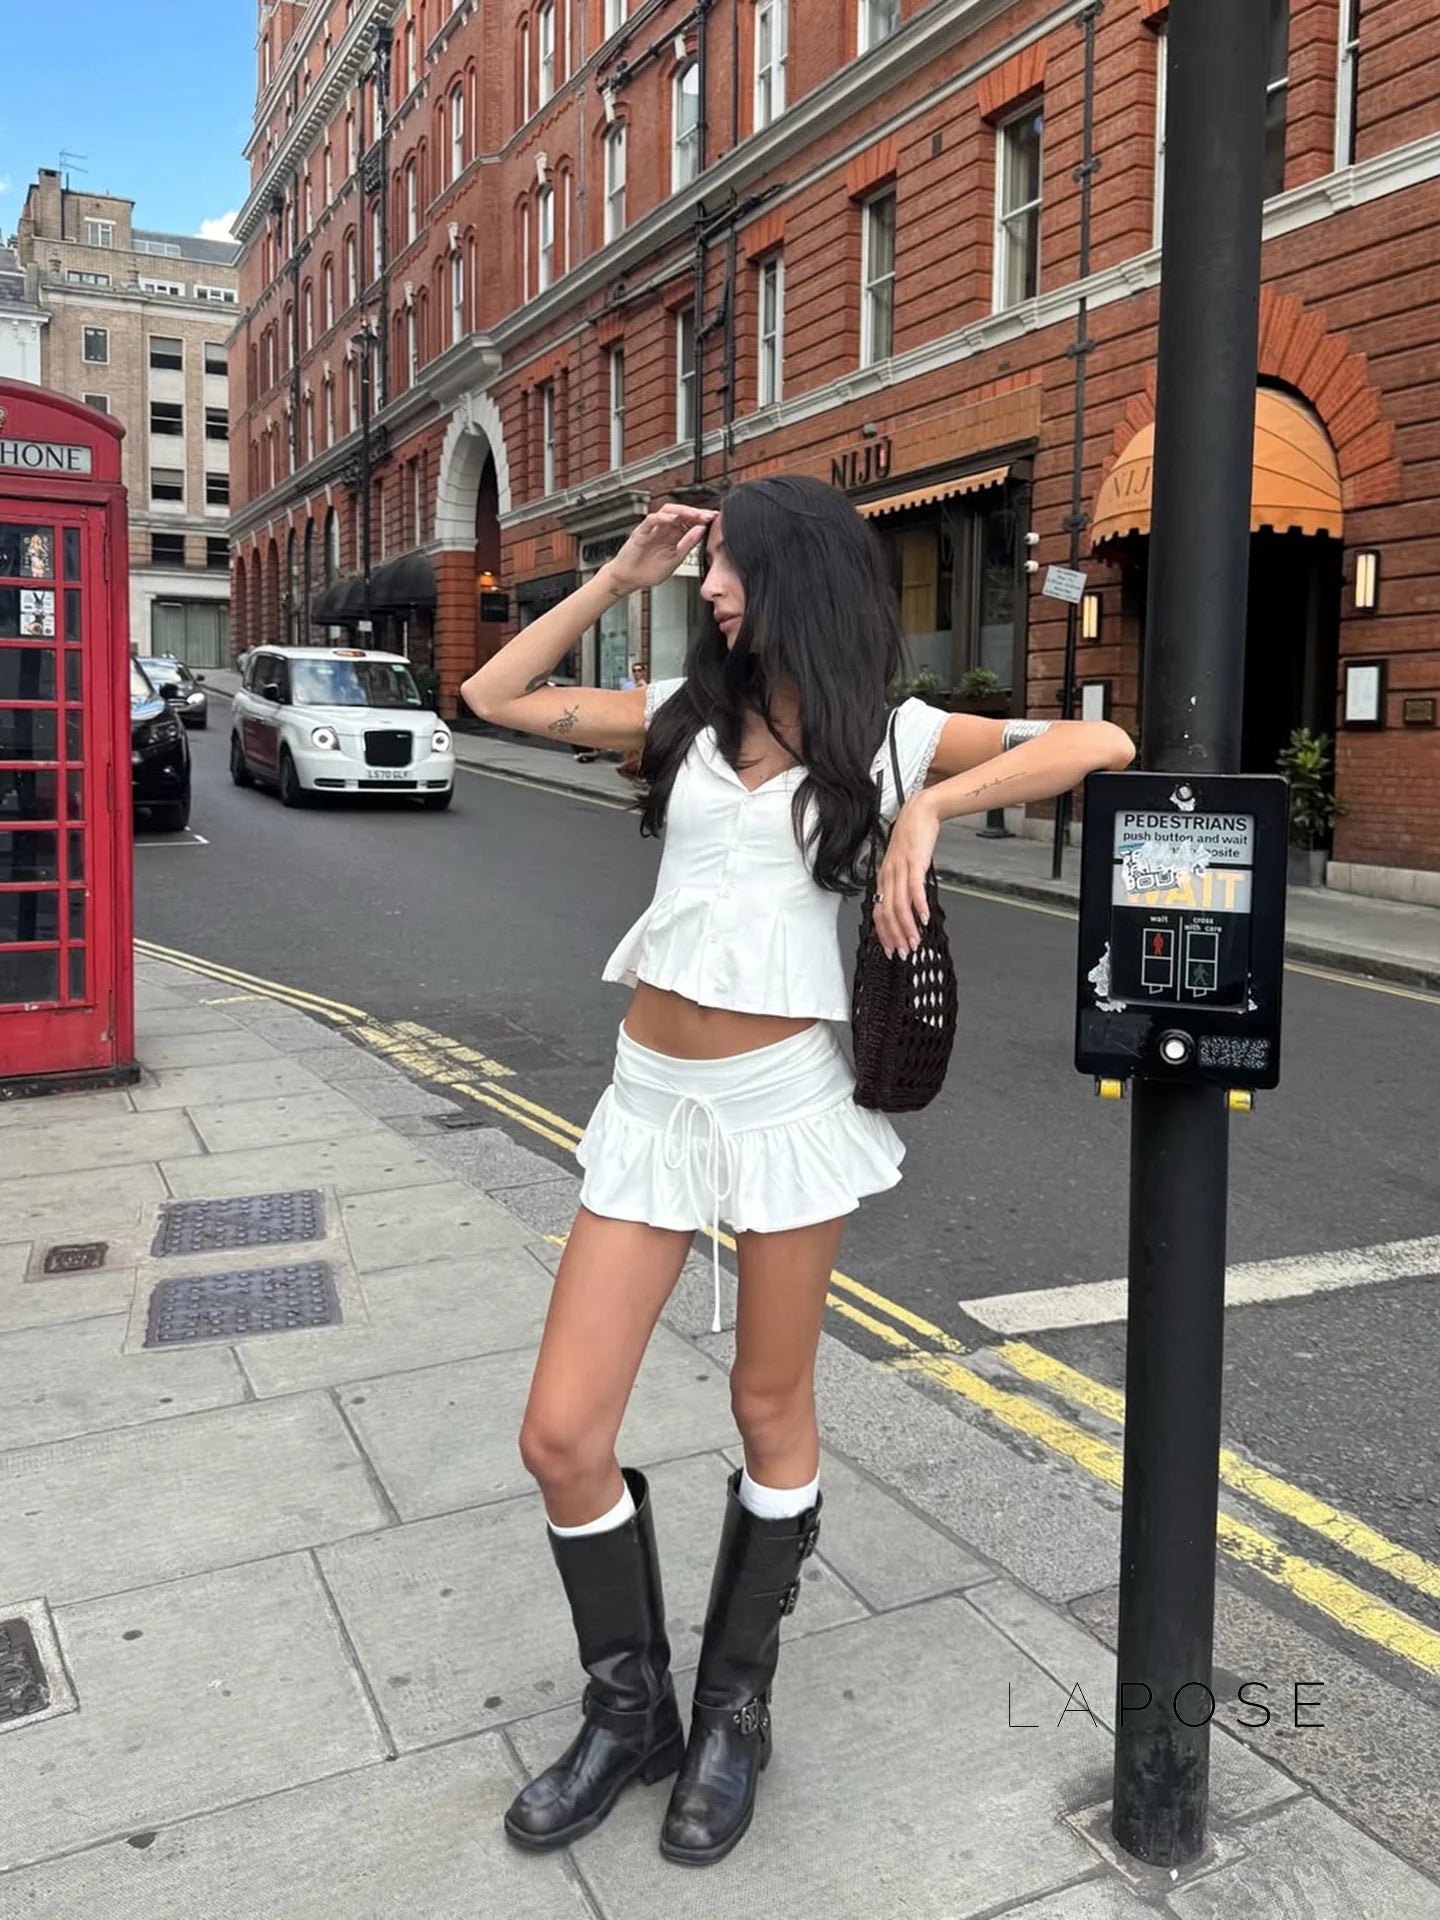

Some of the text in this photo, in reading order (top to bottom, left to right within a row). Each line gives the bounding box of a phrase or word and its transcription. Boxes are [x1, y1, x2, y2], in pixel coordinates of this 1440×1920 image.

[1124, 814, 1247, 831] PEDESTRIANS
[1123, 832, 1248, 845] push button and wait
[1150, 915, 1168, 923] wait
[1192, 916, 1214, 924] cross
[1204, 925, 1222, 933] care
